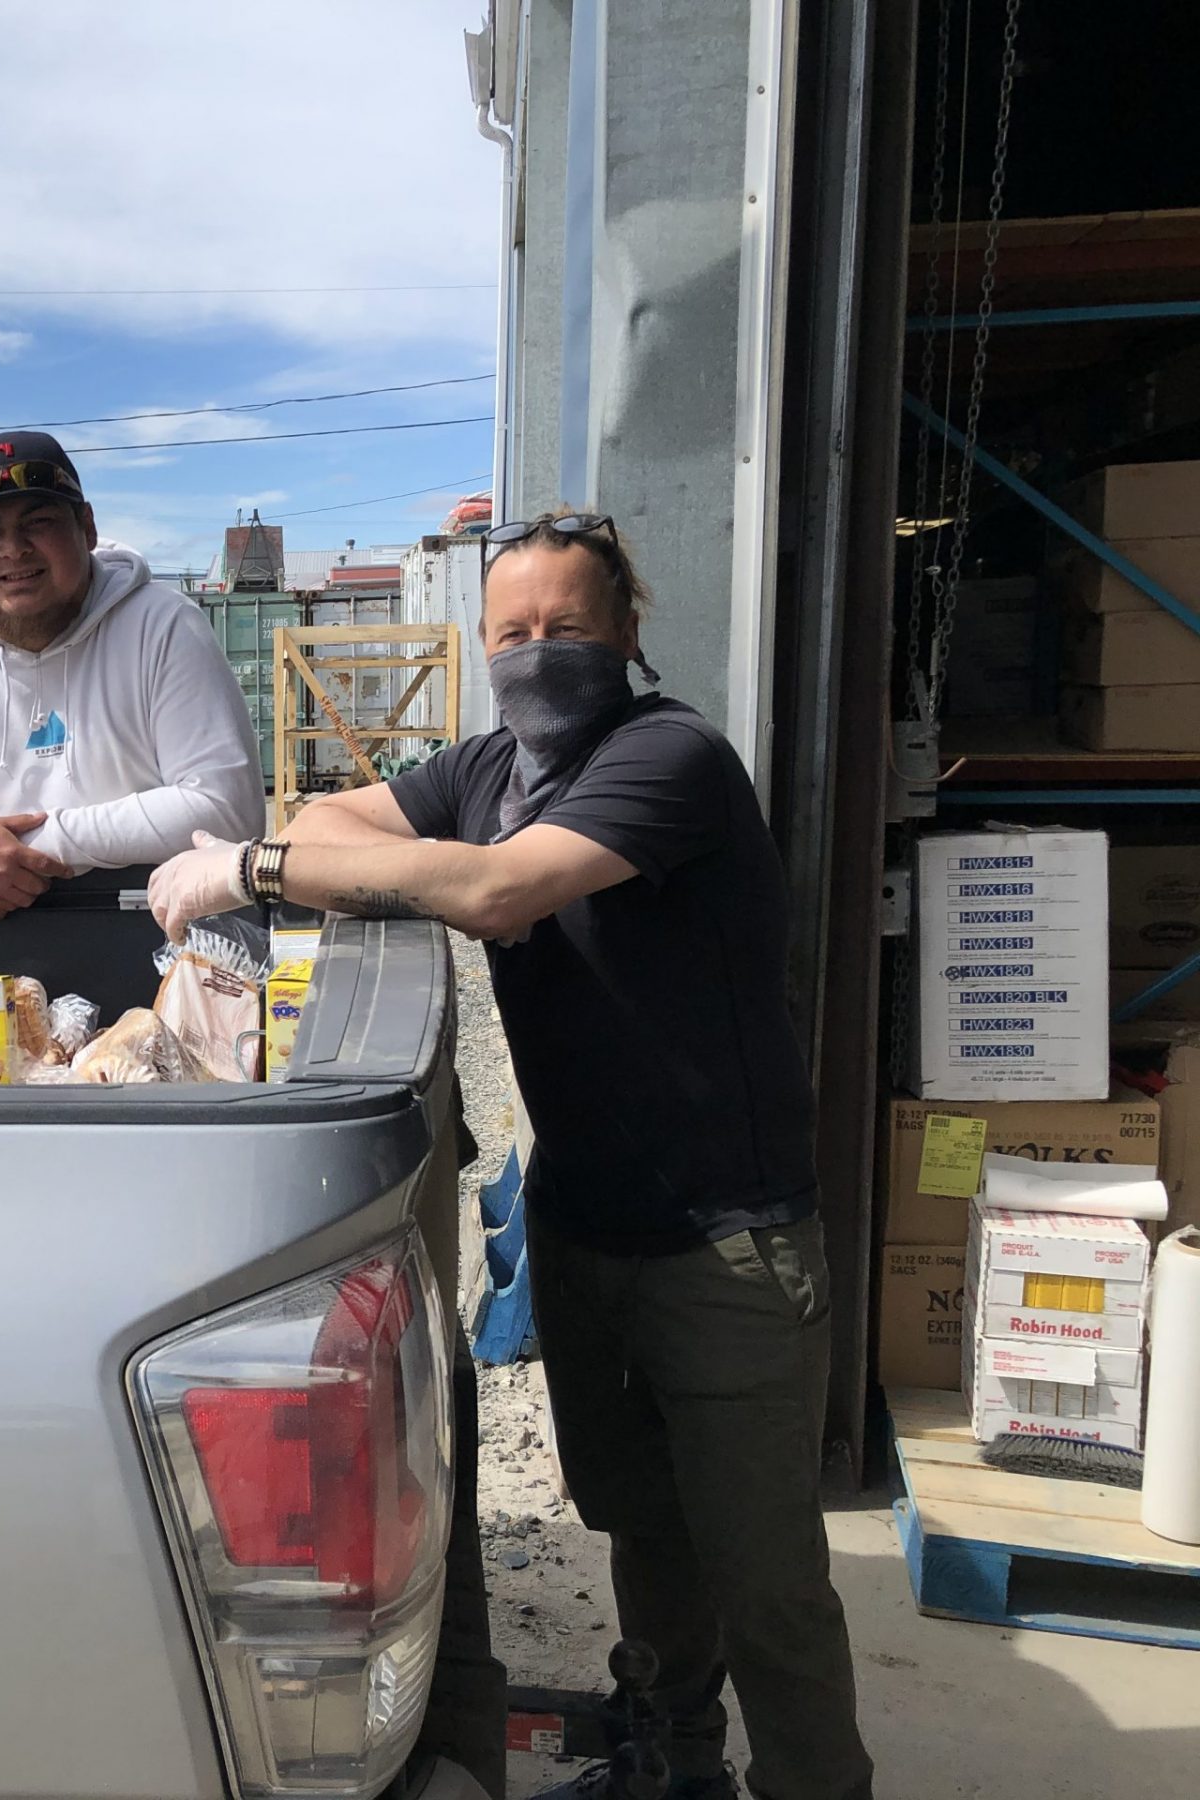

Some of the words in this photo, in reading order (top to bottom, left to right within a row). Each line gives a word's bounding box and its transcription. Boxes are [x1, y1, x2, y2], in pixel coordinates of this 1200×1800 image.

[961, 858, 1031, 869] HWX1815
[961, 884, 1031, 895] HWX1816
[961, 911, 1031, 922] HWX1818
[962, 938, 1031, 949] HWX1819
[272, 989, 302, 999] Kellogg's
[962, 992, 1031, 1003] HWX1820
[1035, 992, 1064, 1003] BLK
[962, 1019, 1031, 1030] HWX1823
[963, 1046, 1031, 1057] HWX1830
[1121, 1113, 1155, 1125] 71730
[895, 1120, 924, 1131] BAGS
[1120, 1127, 1155, 1138] 00715
[1095, 1250, 1131, 1259] PRODUCT
[890, 1265, 917, 1276] SACS
[927, 1320, 962, 1333] EXTR
[1010, 1316, 1057, 1334] Robin
[1060, 1323, 1103, 1339] Hood
[1008, 1420, 1056, 1436] Robin
[1059, 1427, 1102, 1441] Hod
